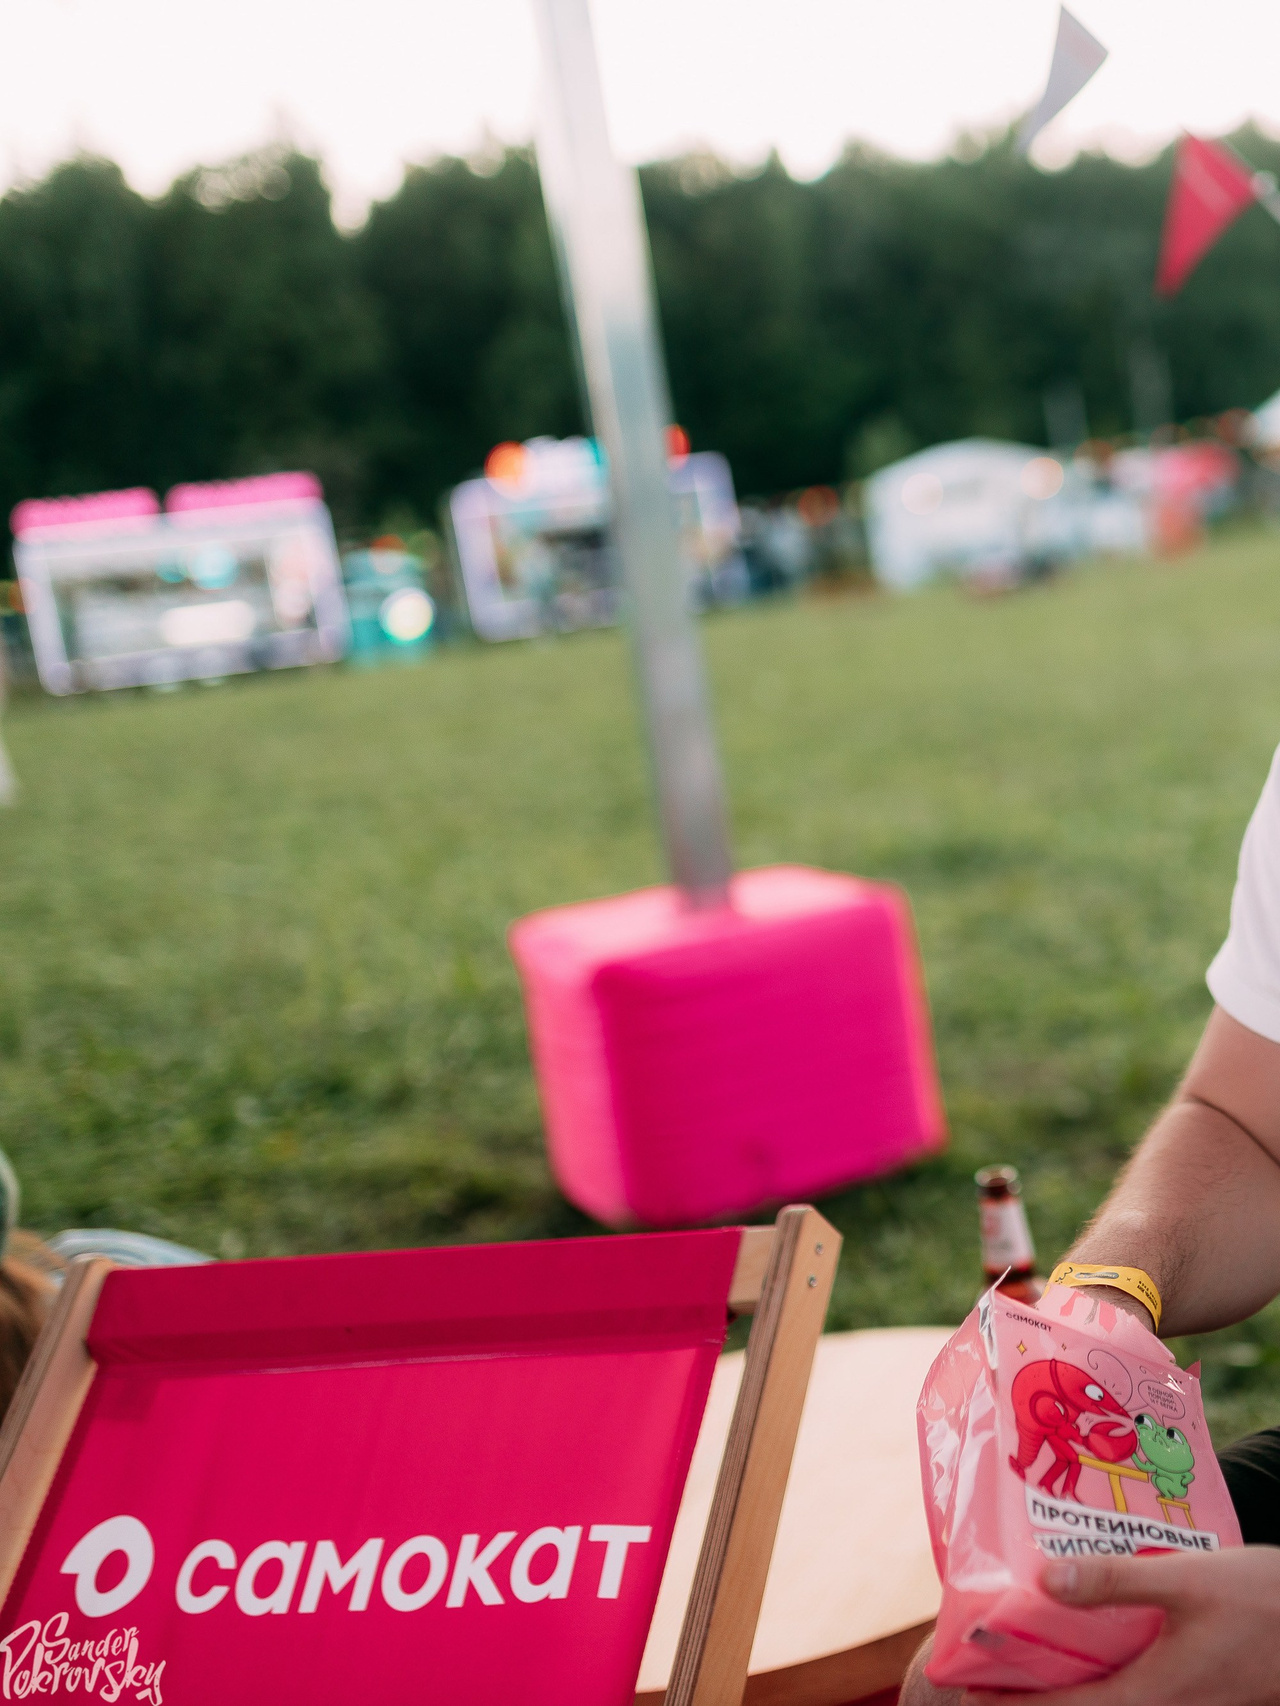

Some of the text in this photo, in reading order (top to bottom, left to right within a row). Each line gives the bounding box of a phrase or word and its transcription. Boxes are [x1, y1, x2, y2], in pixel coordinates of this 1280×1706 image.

[1006, 1312, 1051, 1332] самокат
[1032, 1499, 1213, 1551] ПРОТЕИНОВЫЕ
[1039, 1536, 1135, 1557] ЧИПСЫ
[175, 1525, 652, 1616] самокат
